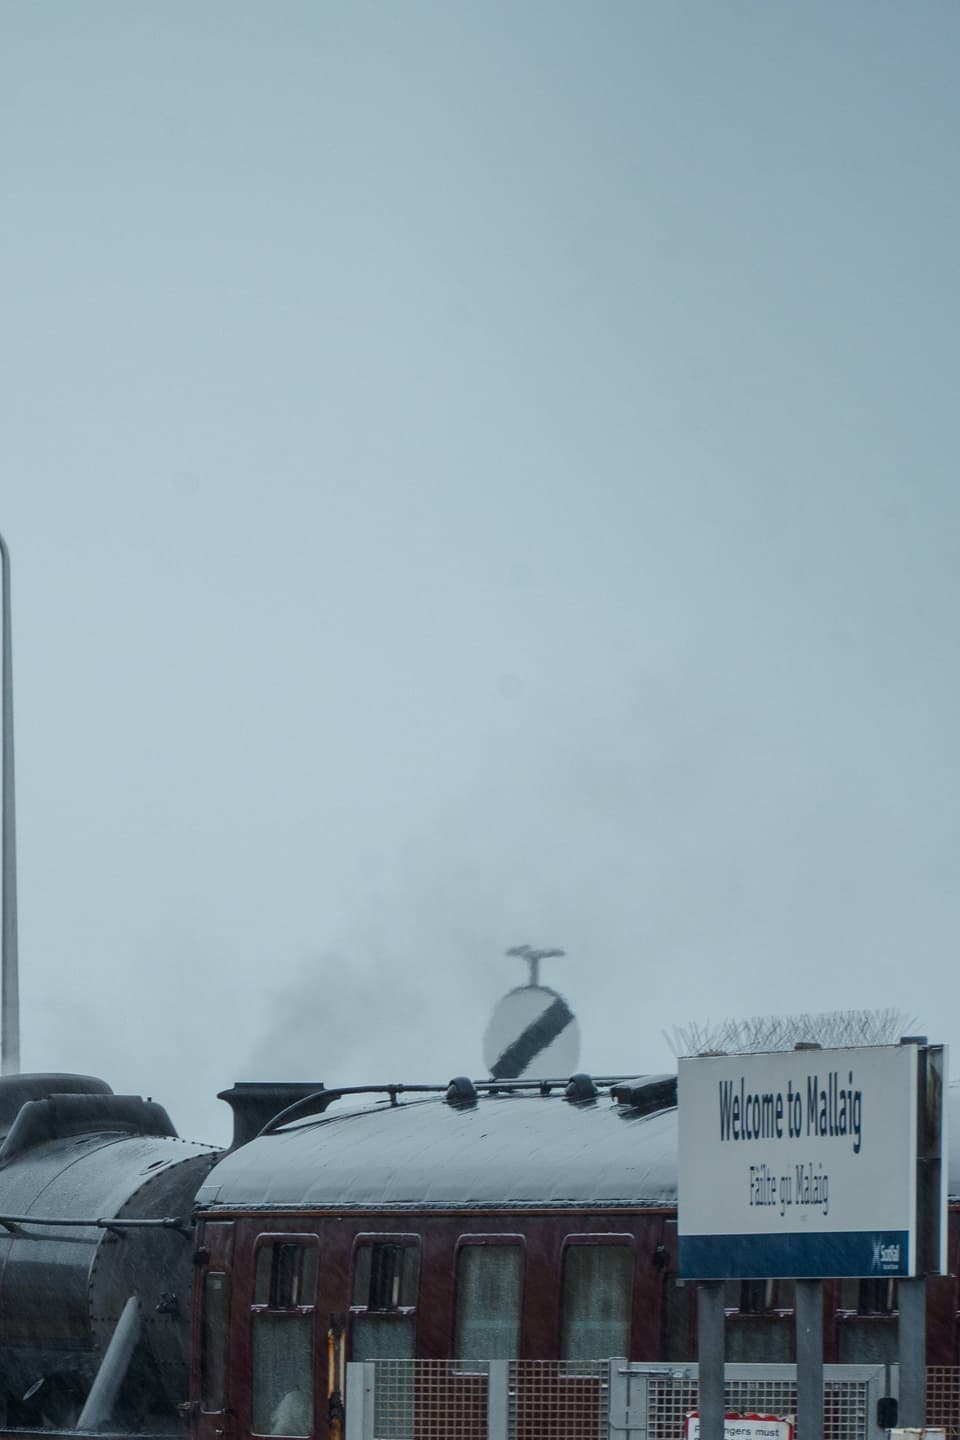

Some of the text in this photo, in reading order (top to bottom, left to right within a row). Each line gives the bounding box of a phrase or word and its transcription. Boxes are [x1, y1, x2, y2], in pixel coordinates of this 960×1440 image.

[719, 1071, 862, 1154] Welcome to Mallaig
[796, 1162, 829, 1217] Malaig
[755, 1428, 780, 1437] must
